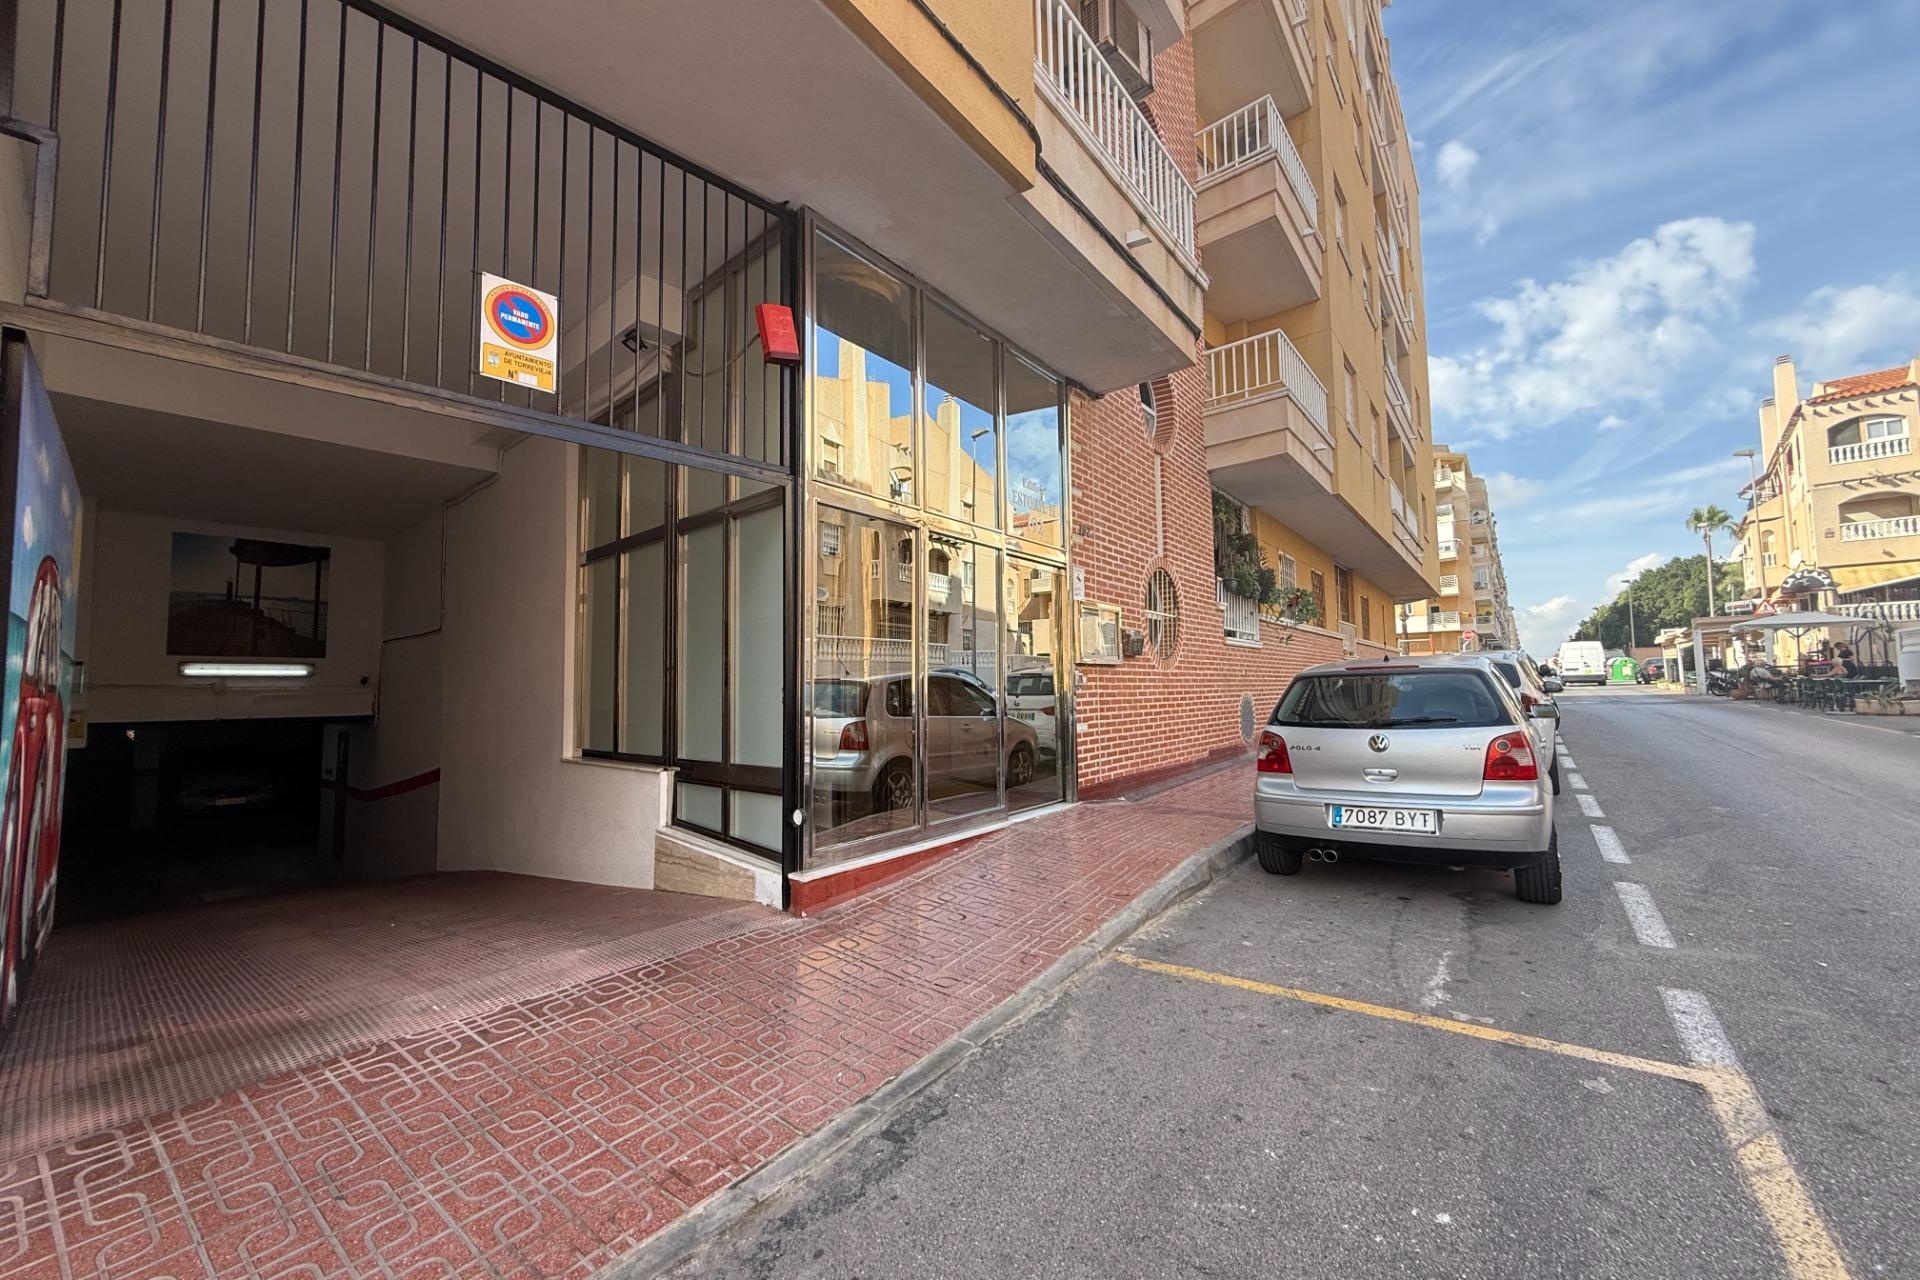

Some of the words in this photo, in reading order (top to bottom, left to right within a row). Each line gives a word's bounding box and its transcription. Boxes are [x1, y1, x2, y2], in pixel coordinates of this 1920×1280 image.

[500, 311, 540, 331] PERMANENTE
[512, 309, 529, 320] VADO
[503, 357, 513, 366] DE
[515, 360, 552, 376] TORREVIEJA
[504, 351, 552, 369] AYUNTAMIENTO
[1344, 809, 1388, 825] 7087
[1394, 811, 1430, 828] BYT
